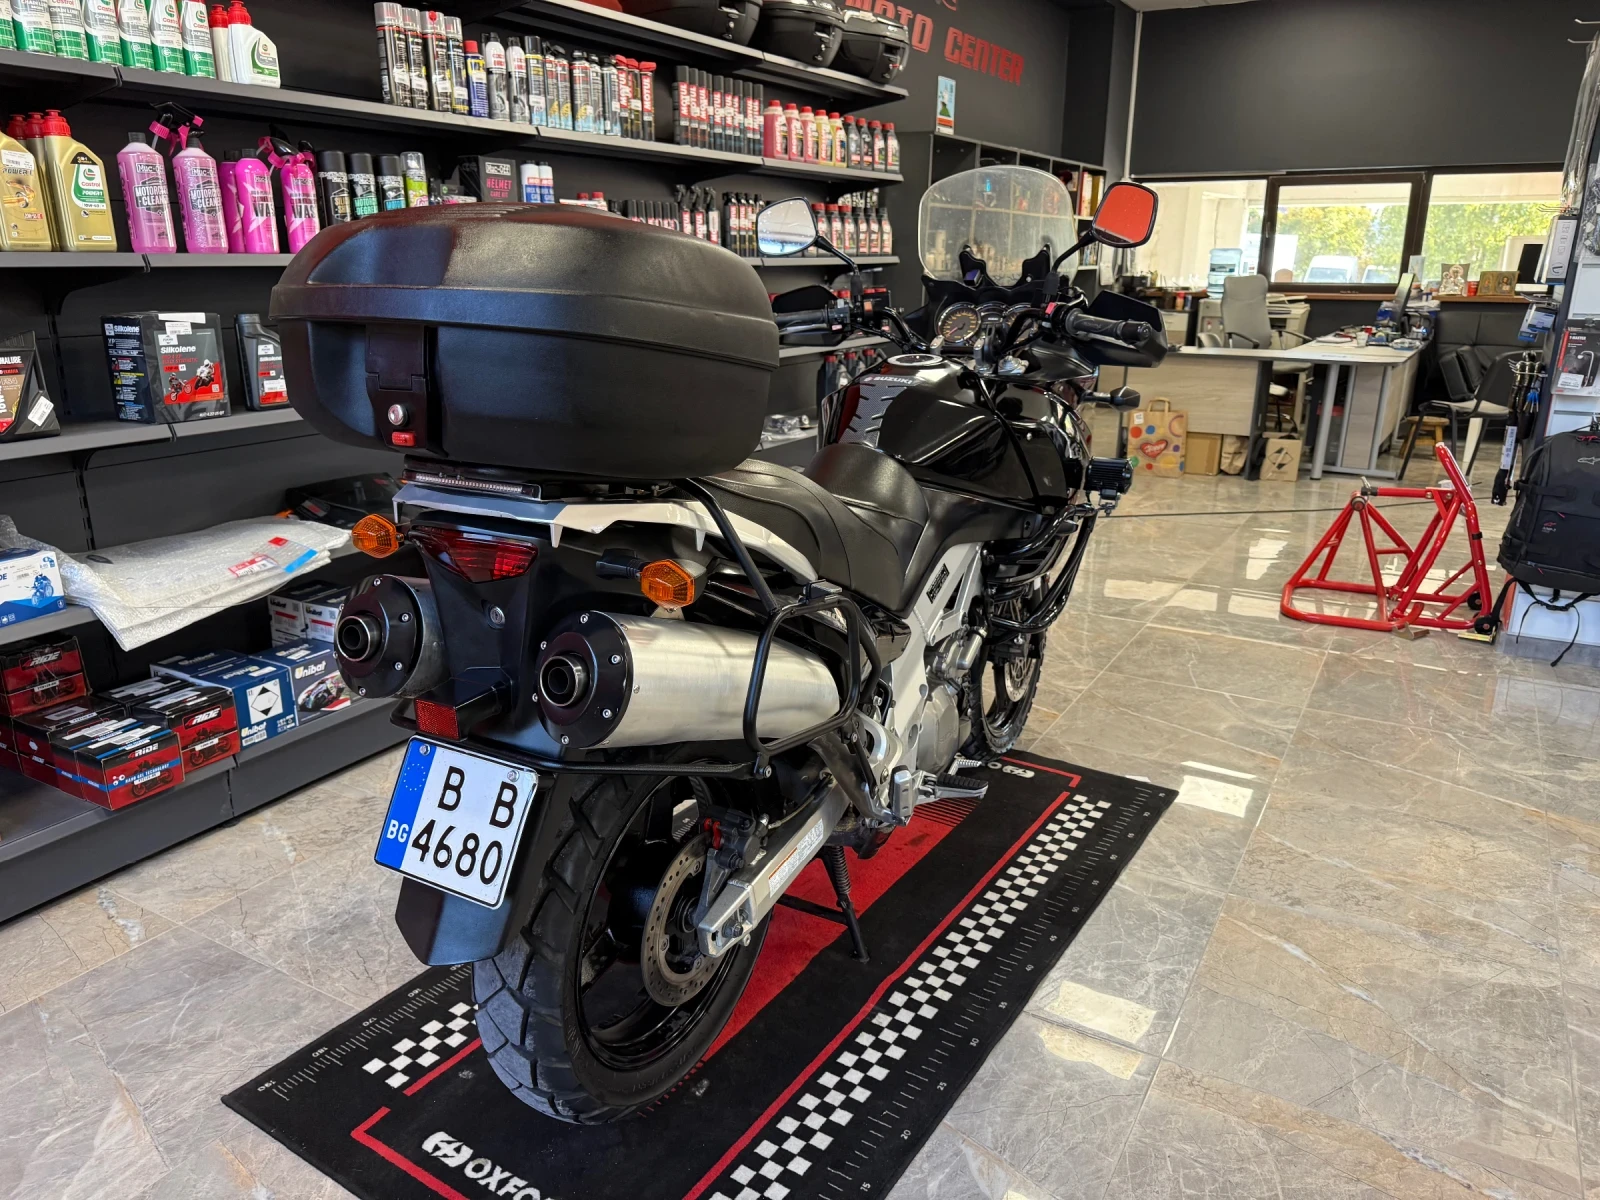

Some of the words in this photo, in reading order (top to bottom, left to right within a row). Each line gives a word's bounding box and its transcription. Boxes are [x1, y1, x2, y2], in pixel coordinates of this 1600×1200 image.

[944, 26, 1025, 86] CENTER
[643, 76, 652, 110] MOTUL
[486, 178, 512, 190] HELMET
[292, 204, 317, 218] WAS
[160, 345, 196, 354] Silkolene
[874, 376, 913, 385] SUZUKI
[295, 661, 326, 679] Unibat
[241, 721, 267, 737] Unibat
[437, 765, 465, 811] B
[489, 781, 518, 828] B
[386, 819, 409, 843] BG
[411, 819, 503, 885] 4680
[1025, 964, 1035, 972] 40
[998, 1001, 1008, 1009] 35
[362, 1016, 377, 1027] 170
[969, 1037, 980, 1047] 30
[936, 1081, 947, 1091] 25
[900, 1129, 912, 1140] 20
[464, 1157, 556, 1200] OXFO
[860, 1181, 871, 1192] 15
